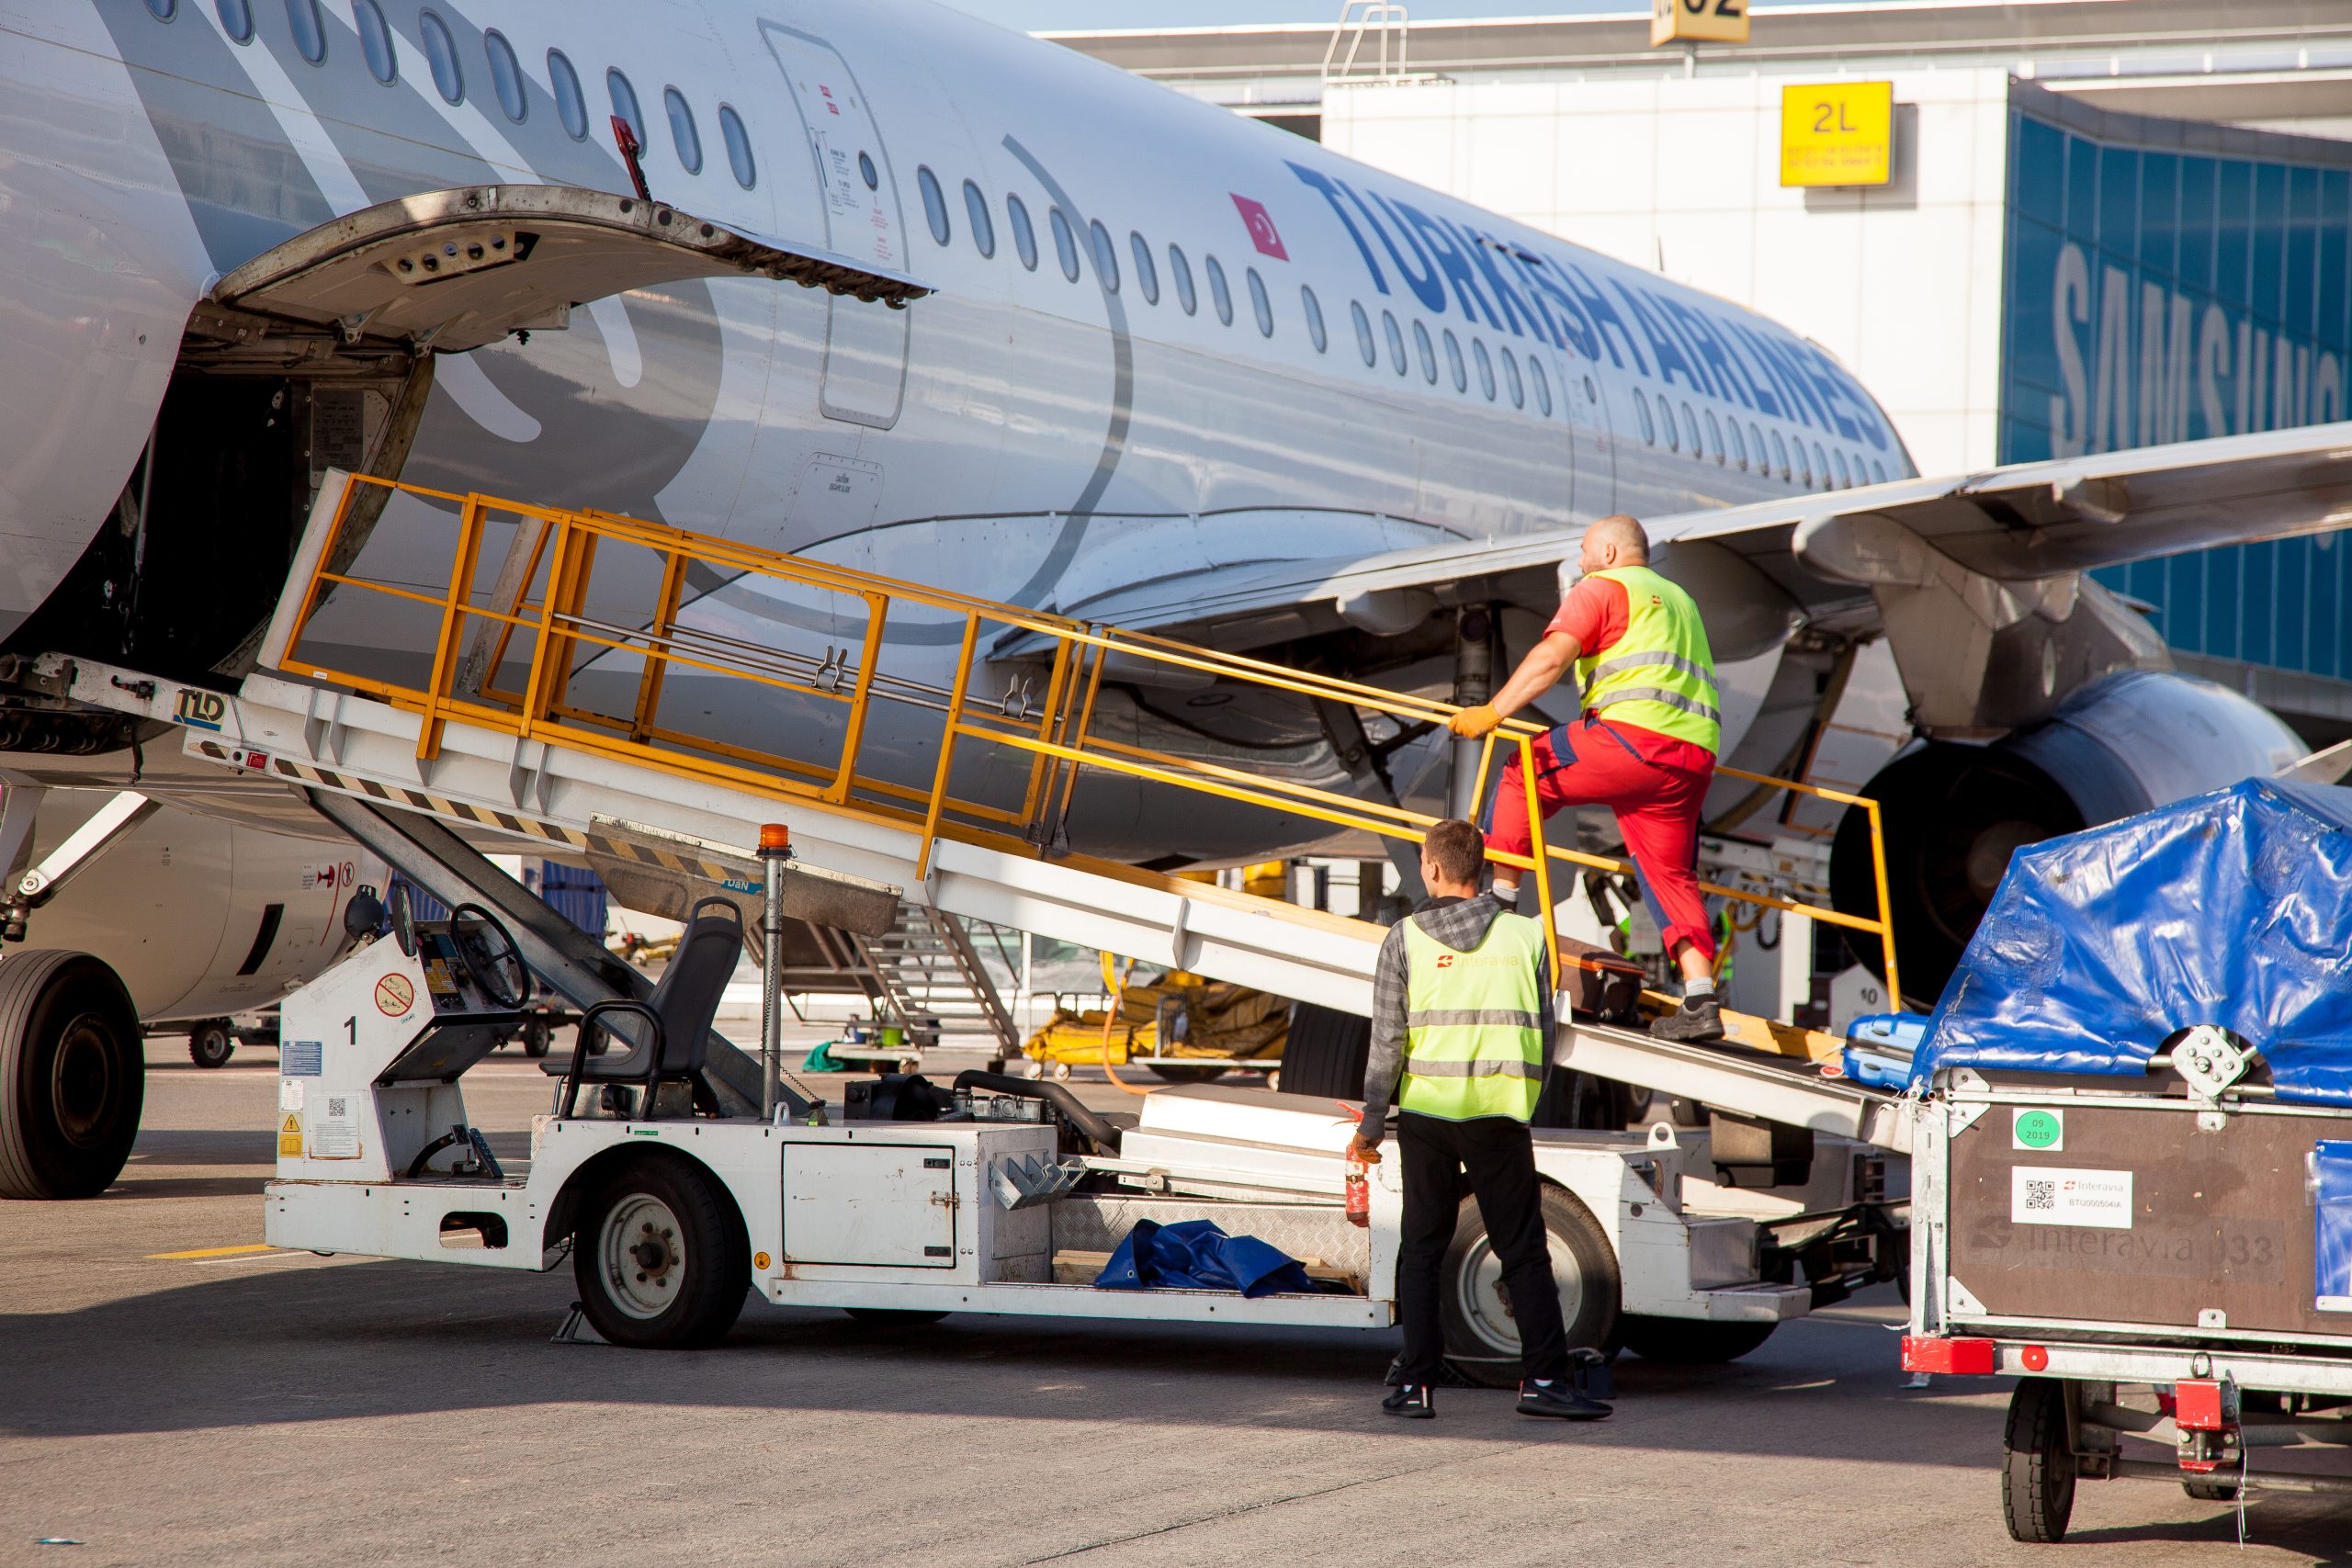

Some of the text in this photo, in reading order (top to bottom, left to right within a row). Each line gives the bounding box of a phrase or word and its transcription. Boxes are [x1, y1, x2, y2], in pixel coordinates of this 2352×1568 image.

[1814, 102, 1859, 132] 2L
[1283, 159, 1888, 452] TURKISH AIRLINES
[178, 688, 225, 723] TLD
[1458, 955, 1518, 967] Interavia
[344, 1015, 356, 1045] 1
[2026, 1131, 2050, 1140] 2019
[2032, 1119, 2044, 1128] 09
[2078, 1181, 2123, 1192] Interavia
[2028, 1225, 2194, 1261] Interavia
